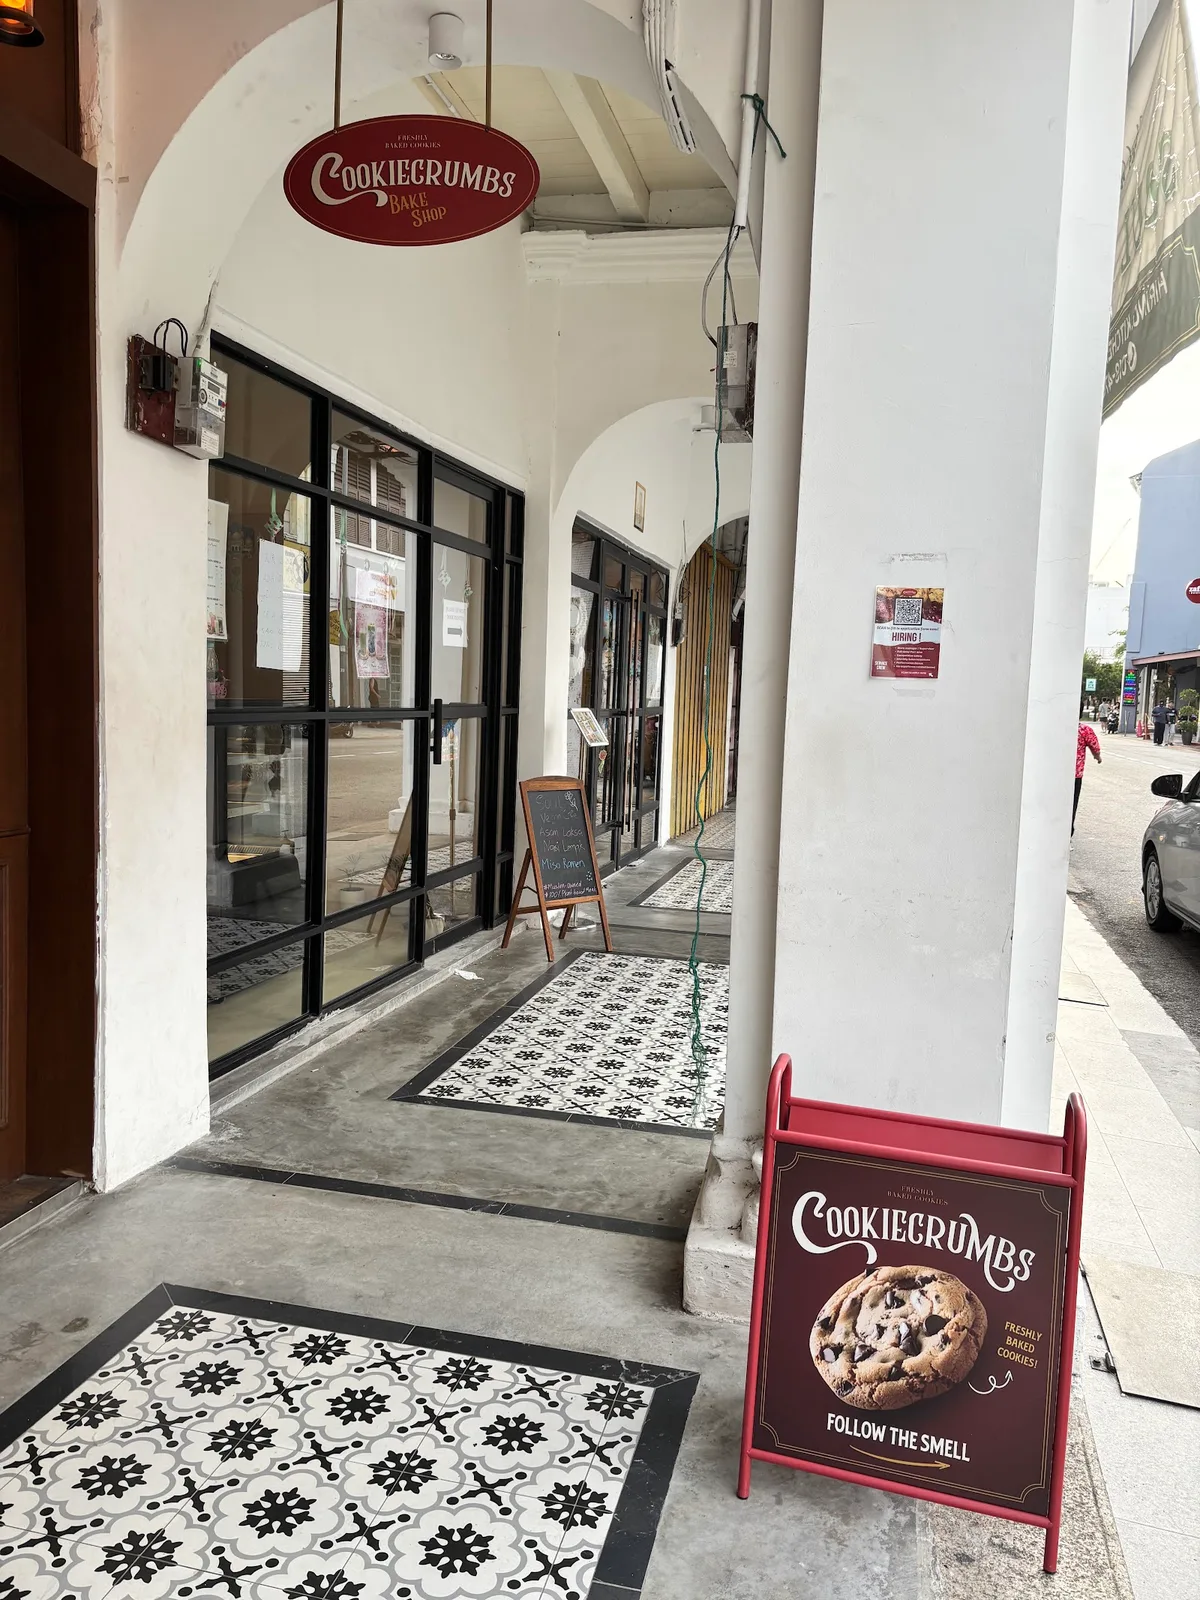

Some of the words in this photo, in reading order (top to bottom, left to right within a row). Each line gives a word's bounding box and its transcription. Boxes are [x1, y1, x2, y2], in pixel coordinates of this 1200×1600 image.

[311, 152, 516, 206] COOKIECRUMBS
[389, 192, 428, 214] BAKE
[411, 206, 447, 227] SHOP
[891, 632, 917, 642] HIRING
[541, 858, 561, 871] Miso
[887, 1190, 912, 1200] BAKED
[914, 1195, 949, 1206] COOKIES
[901, 1185, 934, 1196] FRESHLY
[792, 1191, 1036, 1292] COOKIECRUMBS
[1004, 1321, 1042, 1342] FRESHLY
[1006, 1336, 1035, 1353] BAKED
[997, 1348, 1038, 1368] COOKIES!
[826, 1412, 886, 1443] FOLLOW
[889, 1426, 918, 1451] THE
[921, 1433, 970, 1462] SMELL
